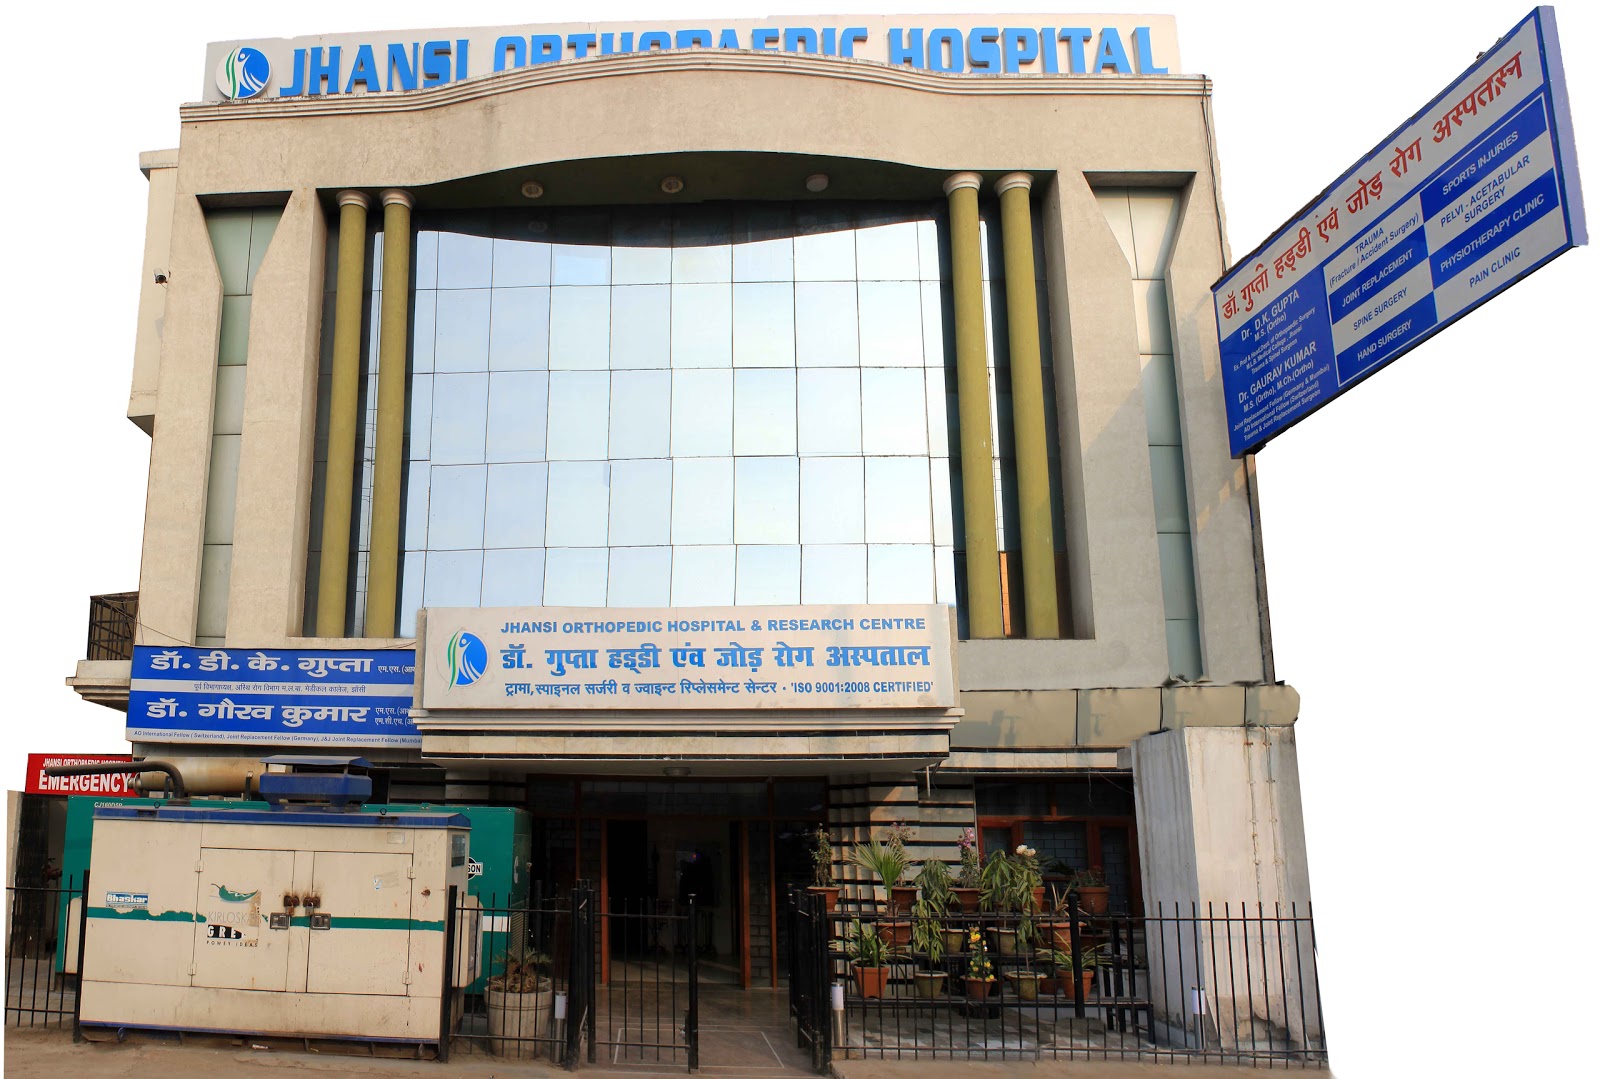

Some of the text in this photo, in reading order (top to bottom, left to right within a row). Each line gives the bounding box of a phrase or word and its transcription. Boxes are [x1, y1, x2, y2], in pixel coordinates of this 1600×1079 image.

[279, 39, 470, 97] JHANSI
[888, 27, 1168, 74] HOSPITAL
[1346, 170, 1383, 200] जोड़
[1389, 136, 1422, 177] रोग
[1442, 131, 1519, 195] SPORTS INJURIES
[1440, 204, 1464, 227] PELVI
[1470, 155, 1530, 206] ACETABULAR
[1464, 186, 1506, 223] SURGERY
[1329, 261, 1356, 288] (Fracture
[1360, 237, 1389, 264] Accident
[1389, 212, 1419, 241] Surgery)
[1355, 227, 1384, 254] TRAUMA
[1440, 193, 1545, 272] PHYSIOTHERAPY CLINIC
[1342, 248, 1413, 307] JOINT REPLACEMENT
[1469, 247, 1521, 288] PAIN CLINIC
[1241, 289, 1299, 341] Dr. D.K. GUPTA
[1254, 312, 1287, 342] M.S. (Ortho)
[1353, 287, 1407, 331] SPINE SURGERY
[1357, 319, 1412, 361] HAND SURGERY
[1238, 341, 1317, 404] Dr. GAURAV KUMAR
[1243, 400, 1255, 413] M.S.
[1243, 404, 1269, 424] Replacement
[1269, 395, 1282, 408] Fellow
[1273, 401, 1301, 422] Replacement
[501, 618, 926, 634] JHANSI ORTHOPEDIC HOSPITAL & RESEARCH CENTRE
[150, 650, 191, 671] डॉ.
[198, 650, 240, 671] डी.
[247, 651, 290, 671] के.
[297, 657, 374, 678] गुप्ता
[500, 644, 533, 669] डॉ.
[545, 649, 599, 676] गुप्ता
[714, 641, 764, 672] जोड़
[772, 641, 814, 667] रोग
[826, 646, 931, 666] अस्पताल
[585, 679, 618, 695] सर्जरी
[622, 682, 631, 694] व
[744, 679, 777, 694] सेन्टर
[815, 682, 870, 693] 9001:2008
[146, 697, 188, 718] डॉ.
[198, 697, 275, 720] गौरव
[281, 705, 371, 728] कुमार
[240, 733, 273, 741] Replacement
[346, 736, 381, 744] Replacement
[38, 769, 132, 793] EMERGENCY
[106, 893, 148, 903] Bhaskar
